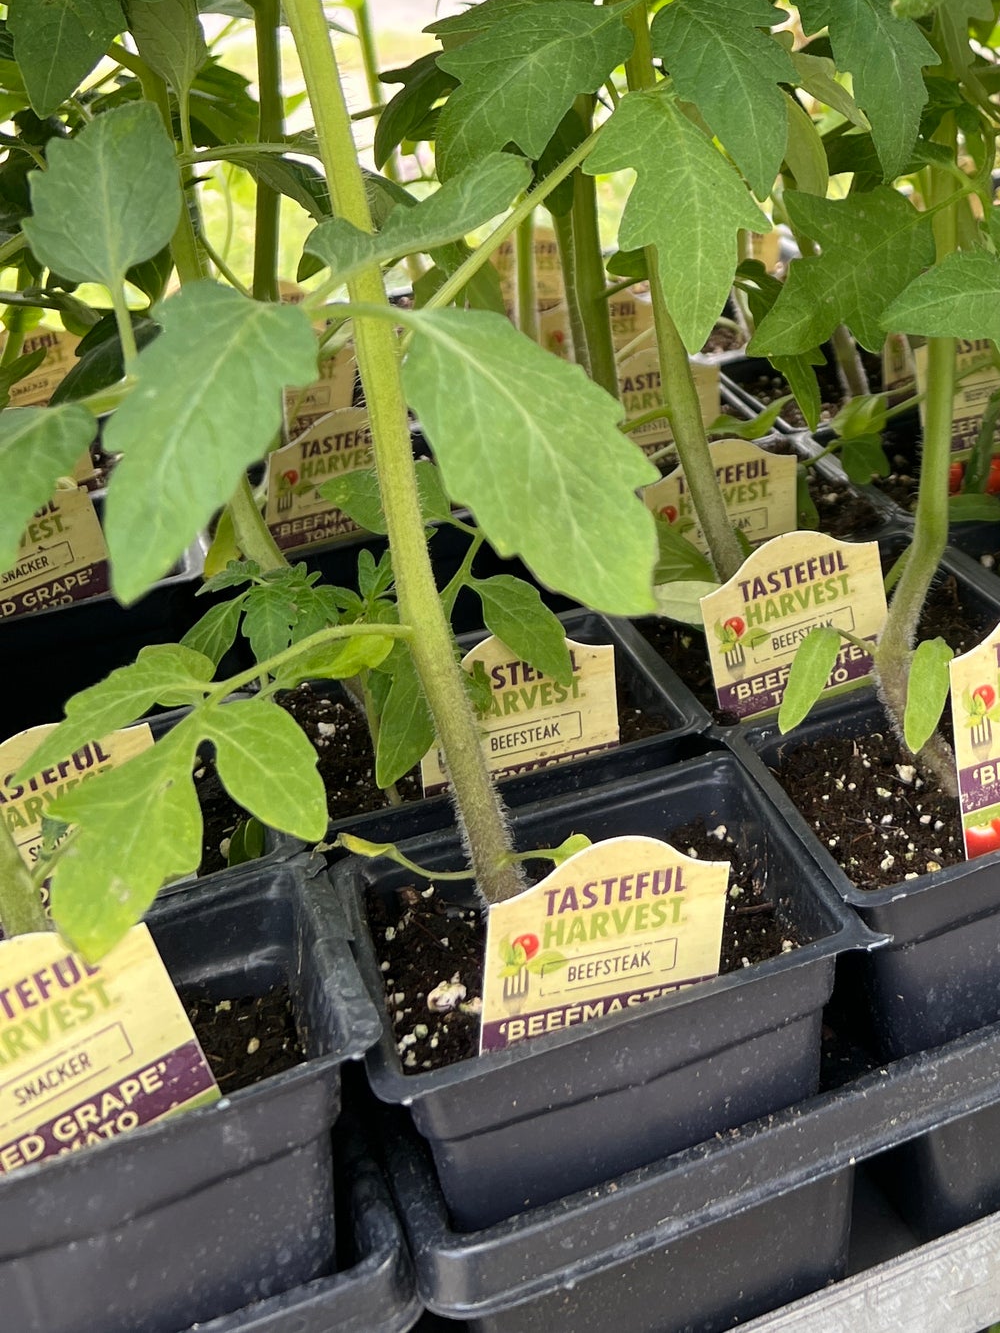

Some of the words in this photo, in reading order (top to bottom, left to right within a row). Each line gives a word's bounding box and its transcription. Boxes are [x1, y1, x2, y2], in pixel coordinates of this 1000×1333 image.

[1, 556, 50, 583] SNACKER
[738, 550, 850, 603] TASTEFUL
[486, 675, 581, 718] ARVEST
[490, 723, 561, 752] BEEFSTEAK
[544, 865, 688, 917] TASTEFUL
[567, 950, 651, 983] BEEFSTEAK
[12, 1052, 92, 1106] SNACKER
[0, 1133, 46, 1173] ED
